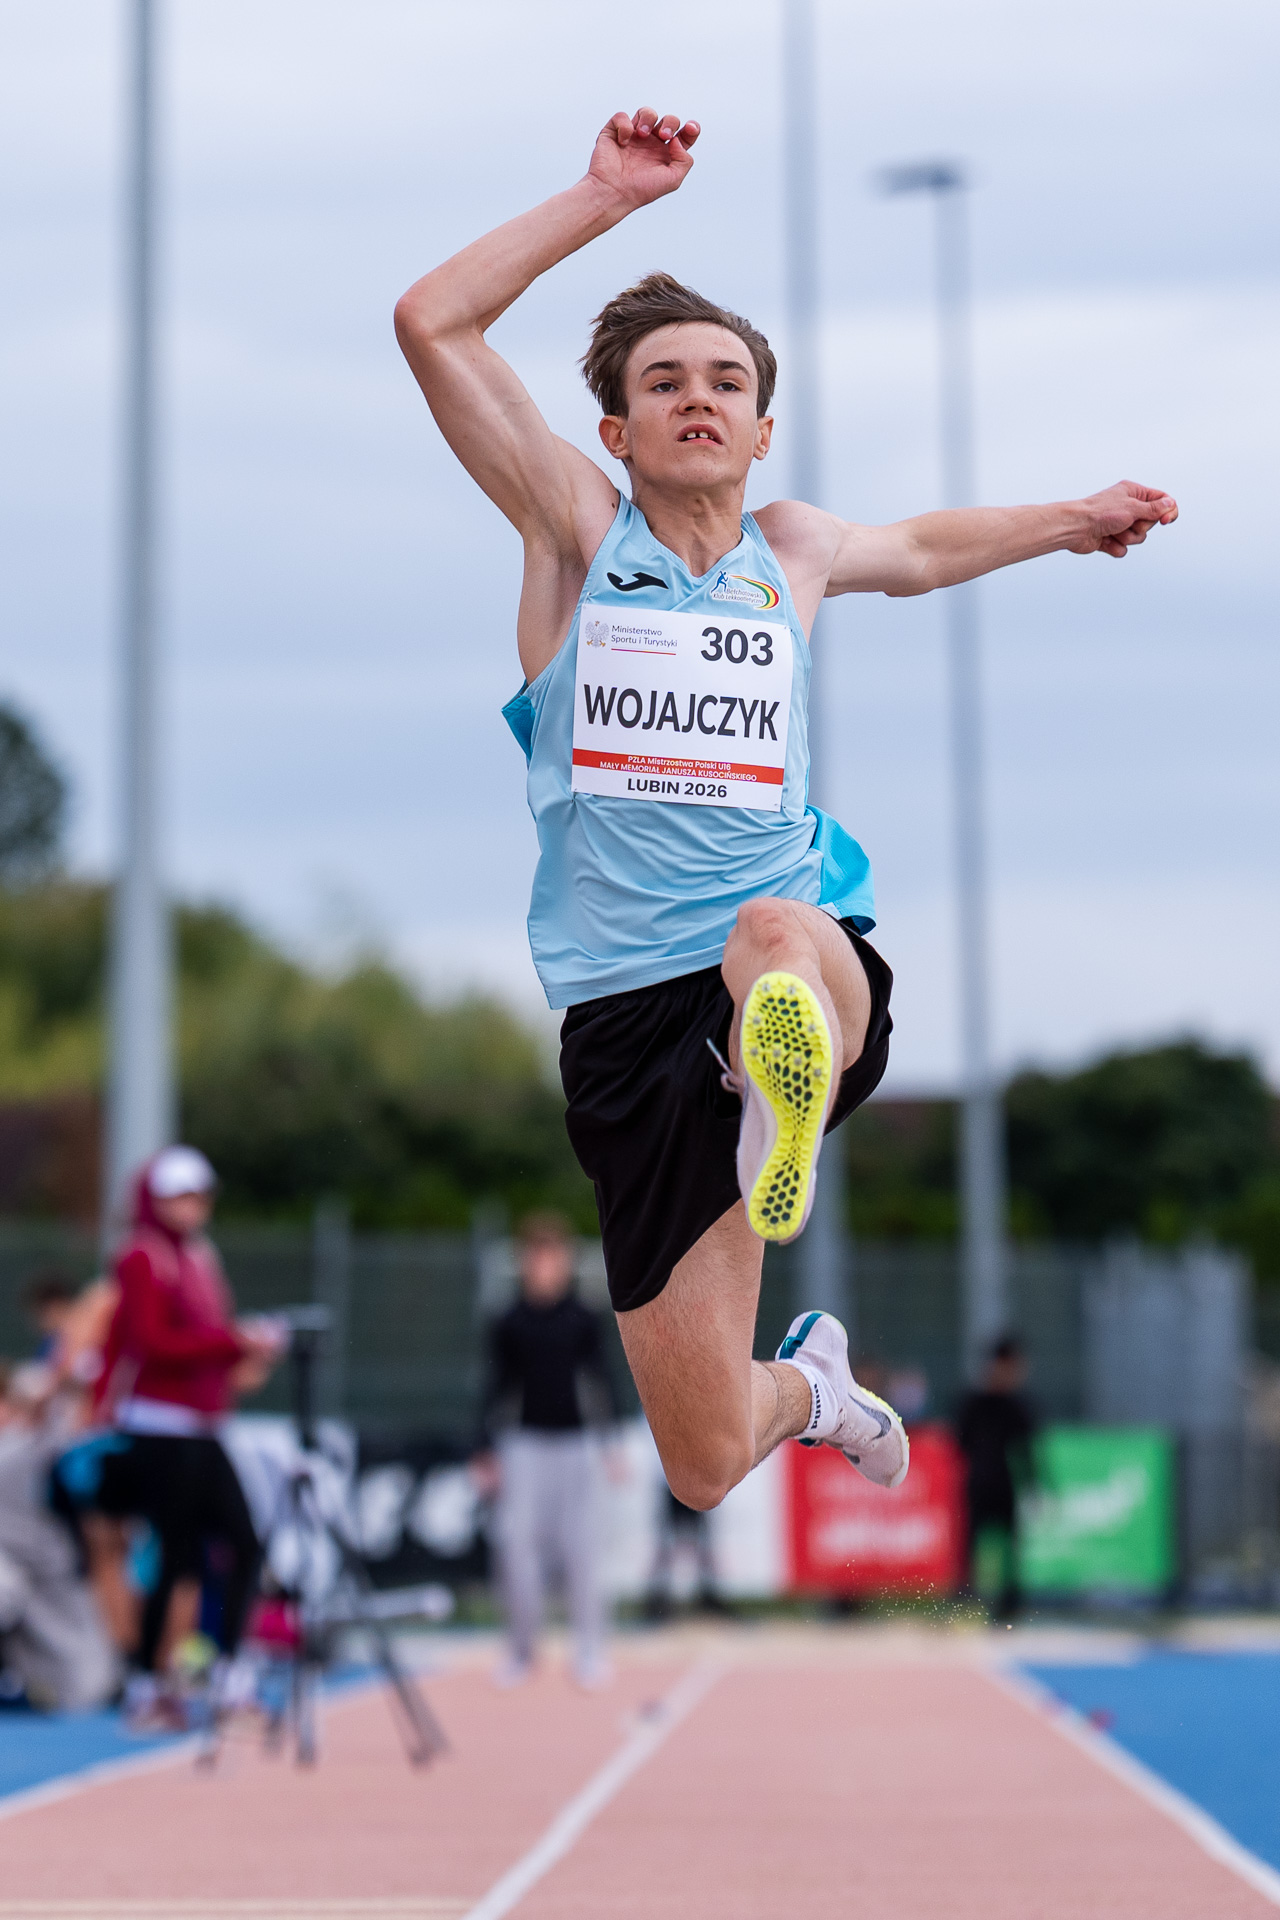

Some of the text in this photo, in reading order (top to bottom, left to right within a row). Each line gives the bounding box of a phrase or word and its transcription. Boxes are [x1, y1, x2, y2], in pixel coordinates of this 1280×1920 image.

[611, 625, 662, 636] Ministerstwo
[611, 634, 637, 644] Sportu
[643, 637, 678, 648] Turystyki
[700, 626, 774, 666] 303
[583, 684, 780, 741] WOJAJCZYK
[600, 761, 757, 781] MAŁY MEMORIAŁ JANUSZA KUSOCIŃSKIEGO
[628, 756, 646, 764] PZLA
[647, 757, 693, 768] Mistrzostwa
[695, 761, 717, 770] Polski
[627, 778, 727, 798] LUBIN 2026
